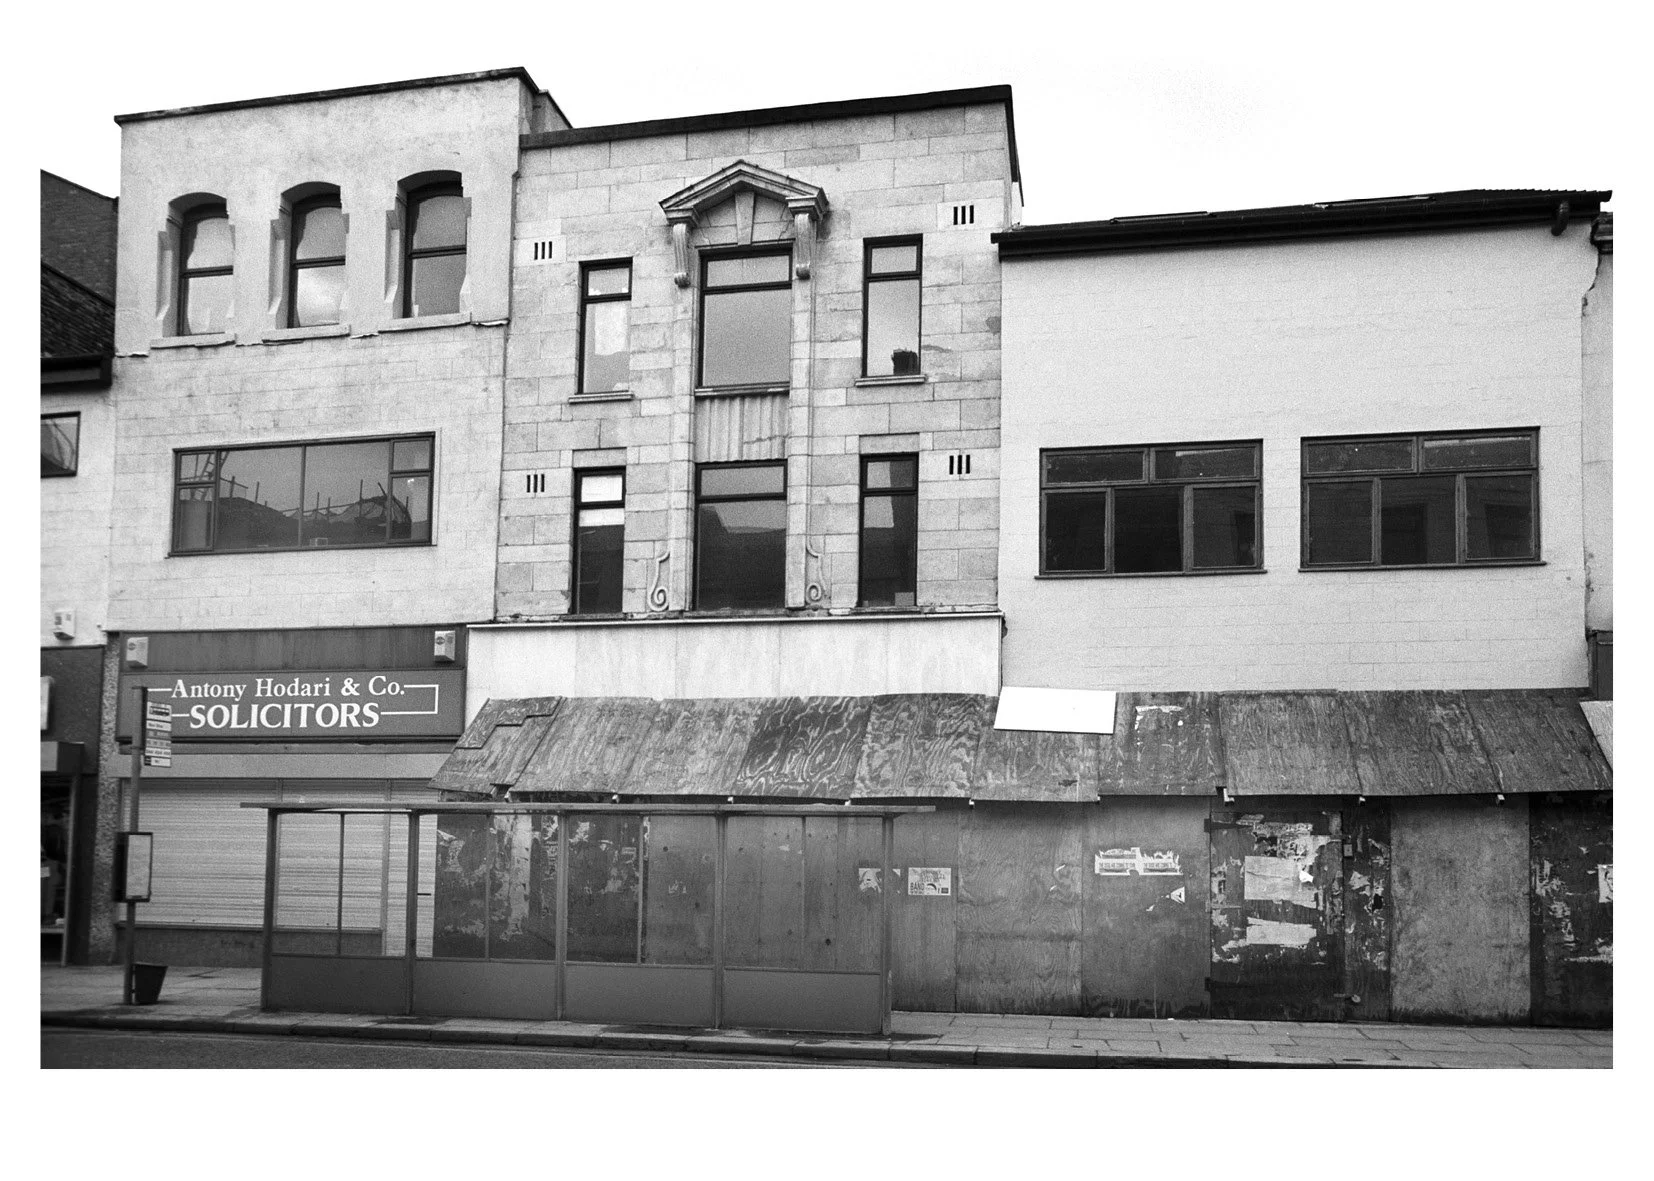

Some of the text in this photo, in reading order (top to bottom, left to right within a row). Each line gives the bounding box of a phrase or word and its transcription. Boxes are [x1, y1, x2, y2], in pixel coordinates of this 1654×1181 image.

[171, 675, 405, 701] Antony Hodari & Co.
[189, 702, 380, 729] SOLICITORS
